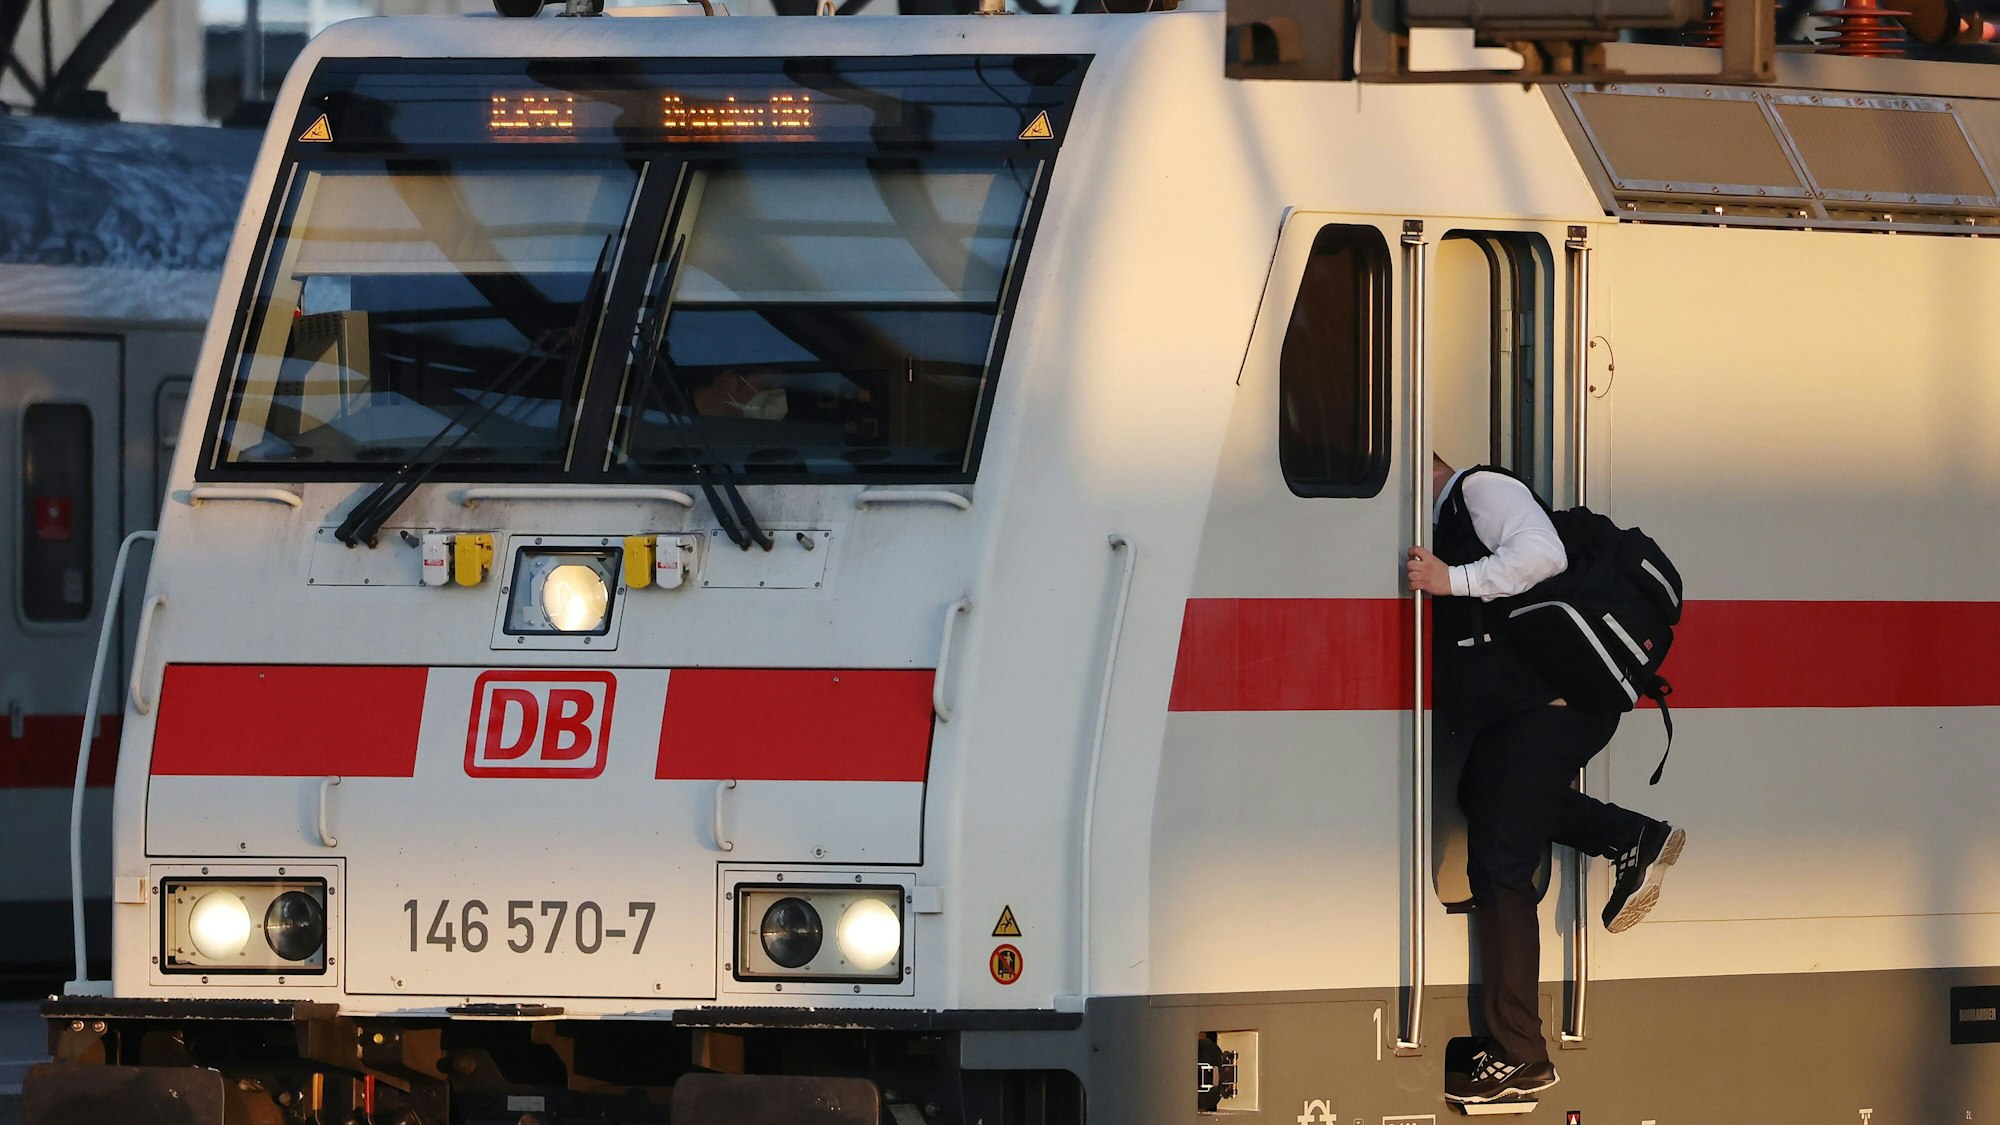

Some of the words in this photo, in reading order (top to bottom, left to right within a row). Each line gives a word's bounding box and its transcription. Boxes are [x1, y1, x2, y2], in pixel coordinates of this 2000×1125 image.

[483, 688, 596, 761] DB
[403, 899, 489, 953] 146
[507, 900, 656, 955] 570-7
[1373, 1008, 1382, 1061] 1
